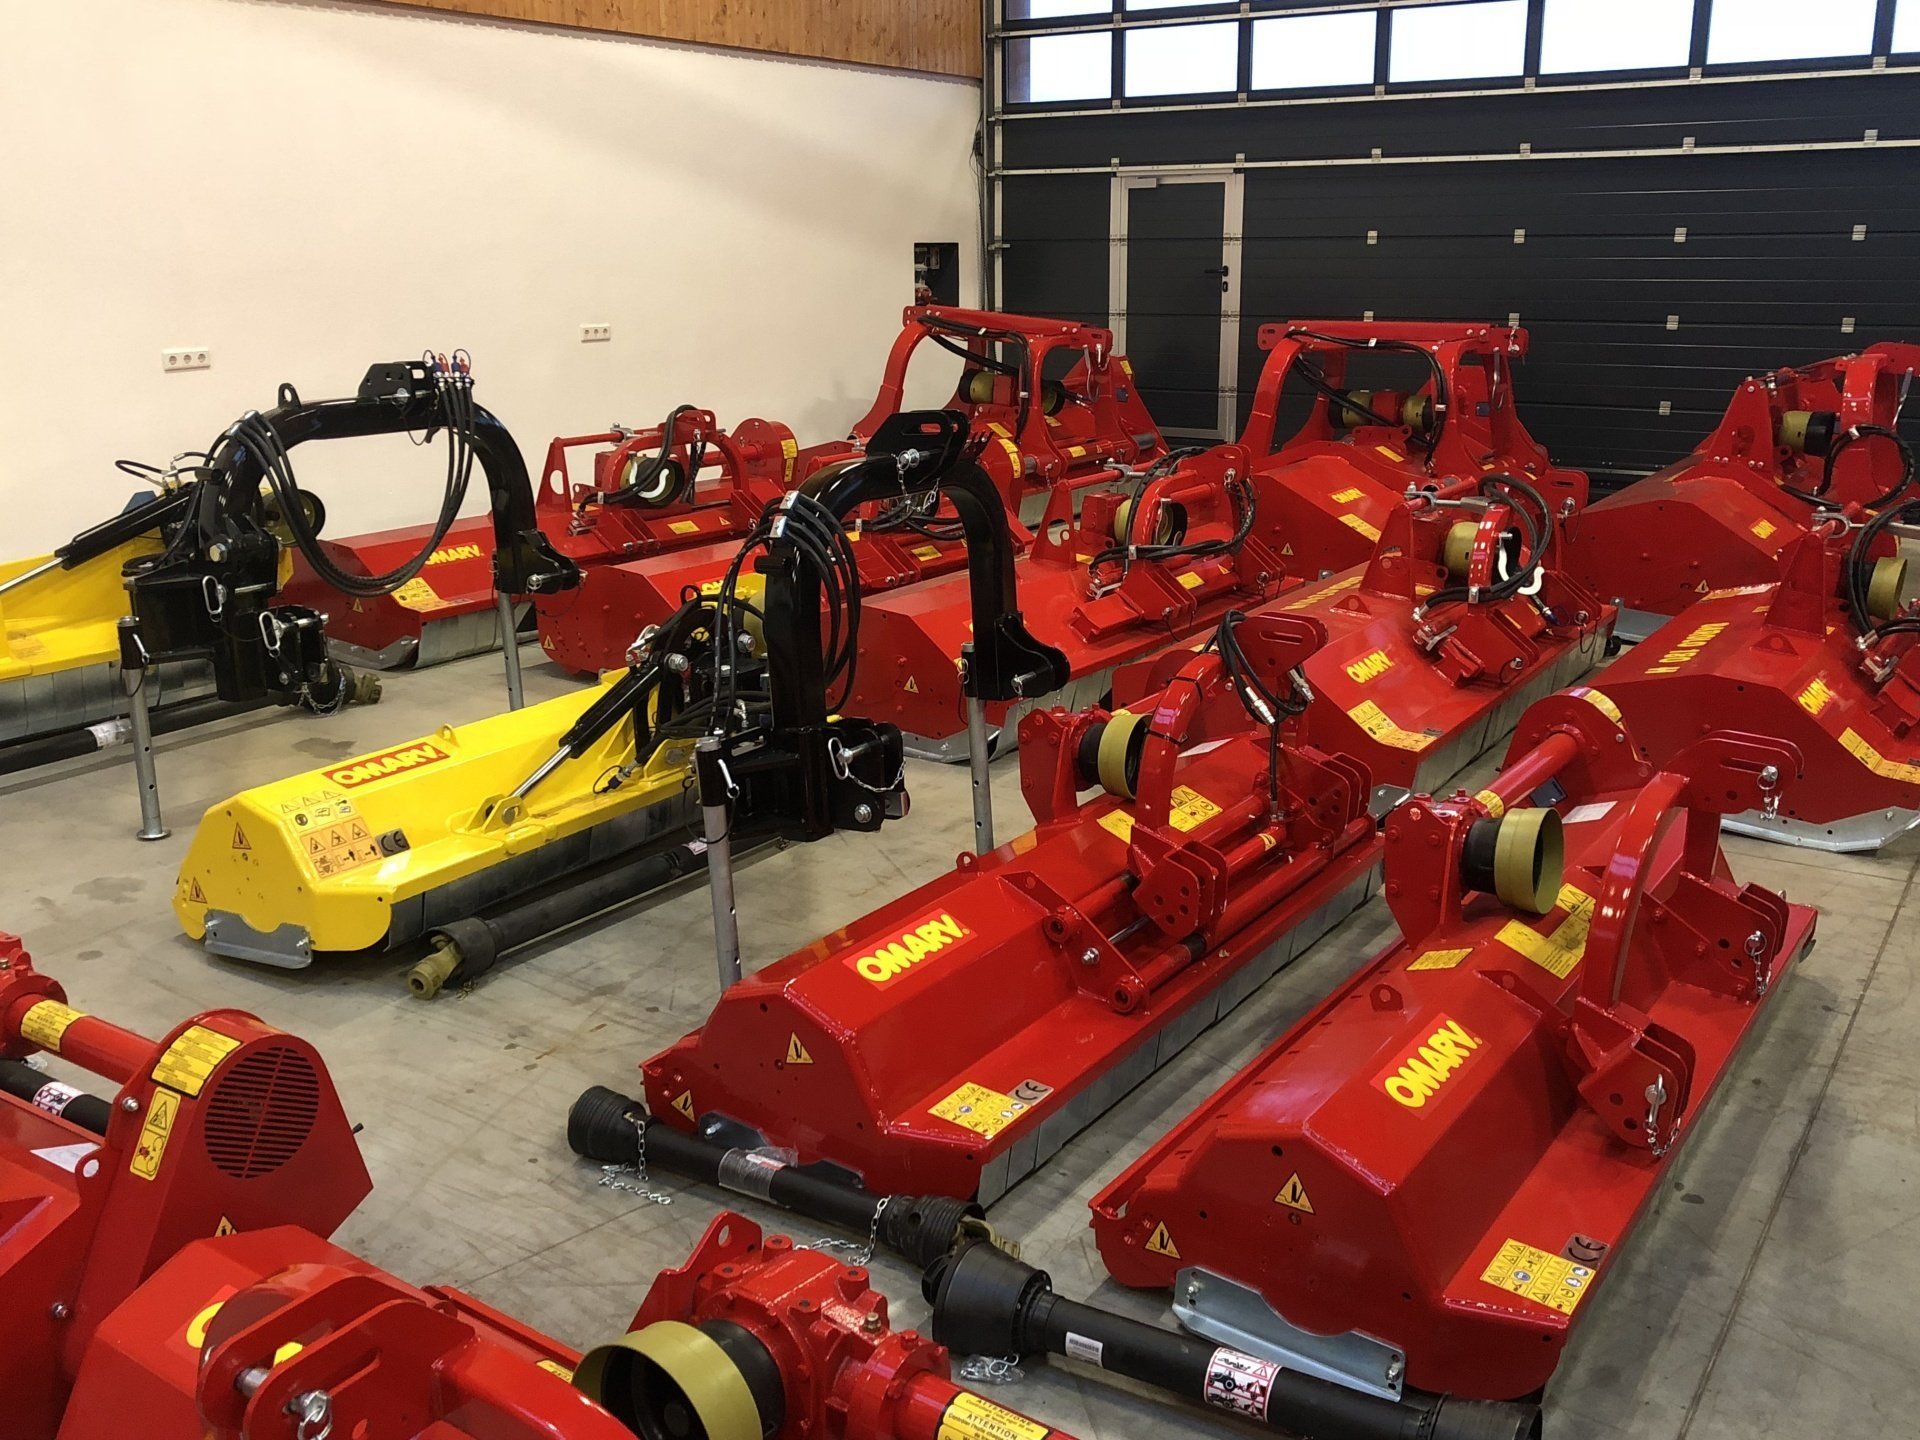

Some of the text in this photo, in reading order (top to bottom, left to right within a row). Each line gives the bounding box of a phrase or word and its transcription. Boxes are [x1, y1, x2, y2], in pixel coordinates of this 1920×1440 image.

[1346, 649, 1393, 684] OMARV
[332, 745, 438, 785] OMARV
[856, 913, 964, 982] OMARV
[1384, 1019, 1478, 1108] OMARV
